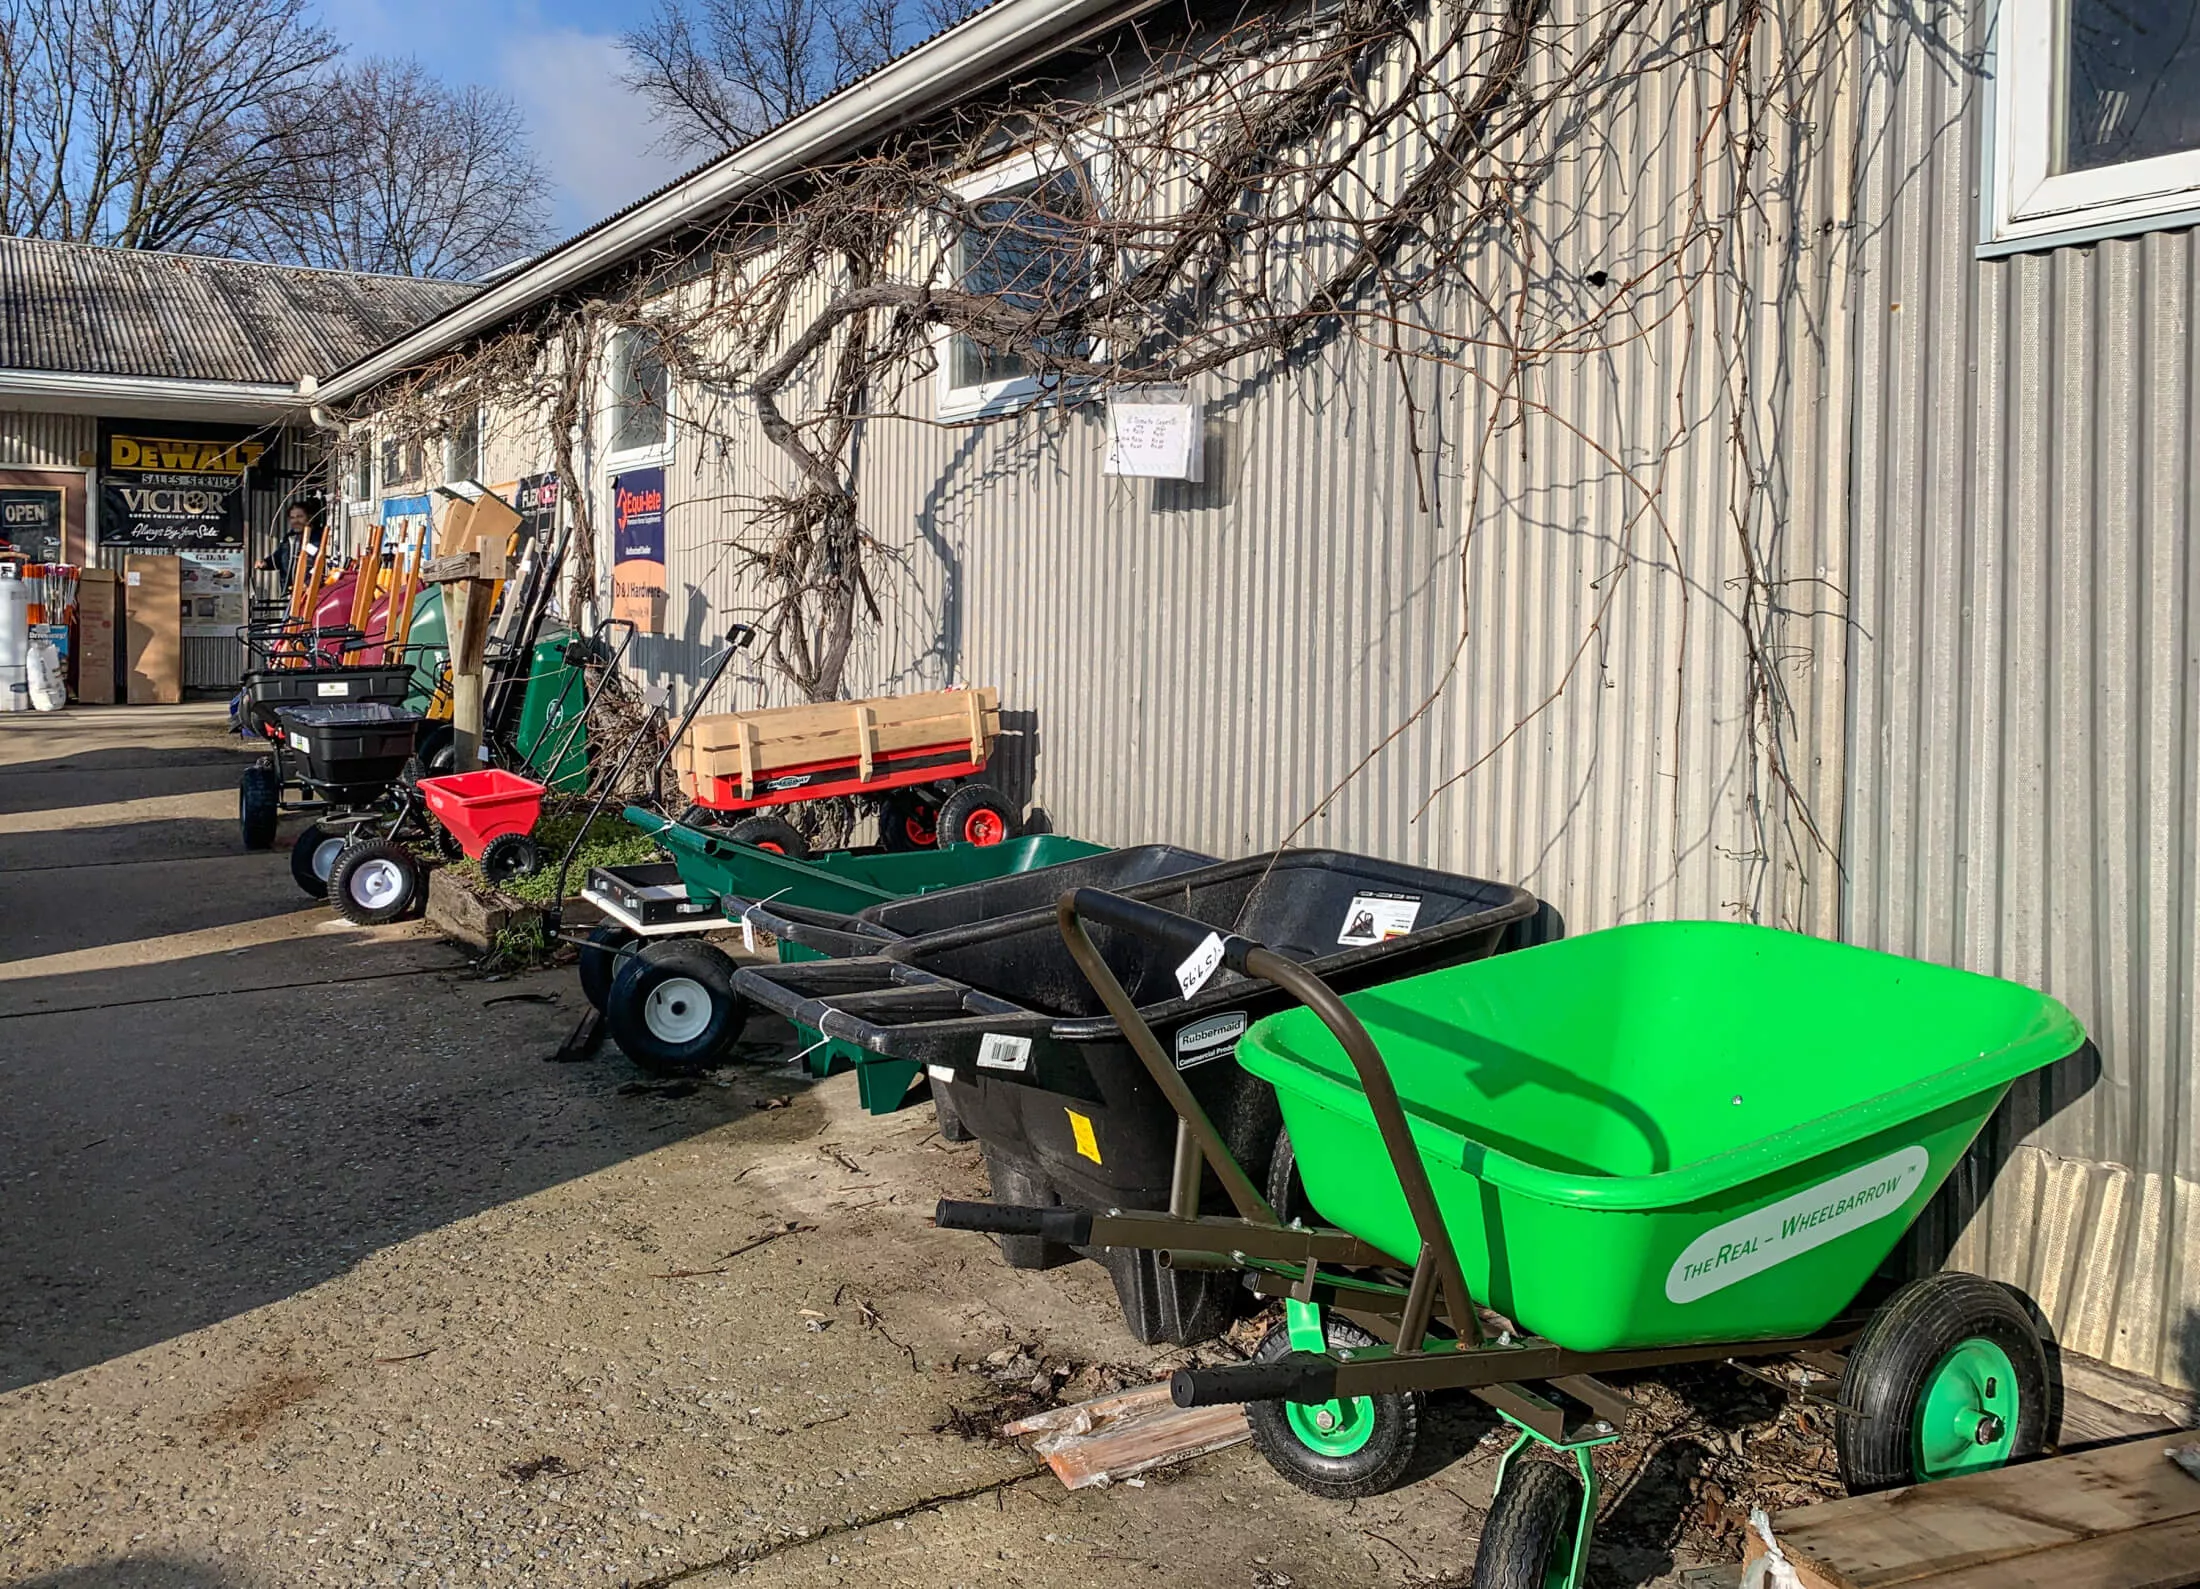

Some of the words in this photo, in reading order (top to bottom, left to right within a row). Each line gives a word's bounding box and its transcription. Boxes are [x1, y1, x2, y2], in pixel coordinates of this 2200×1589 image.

[142, 473, 181, 485] SALES
[5, 504, 45, 522] OPEN
[616, 582, 621, 598] D
[630, 581, 661, 598] Hardware
[1182, 1020, 1241, 1046] Rubbermaid
[1683, 1257, 1713, 1281] THE
[1715, 1237, 1759, 1268] REAL
[1781, 1175, 1902, 1239] WHEELBARROW
